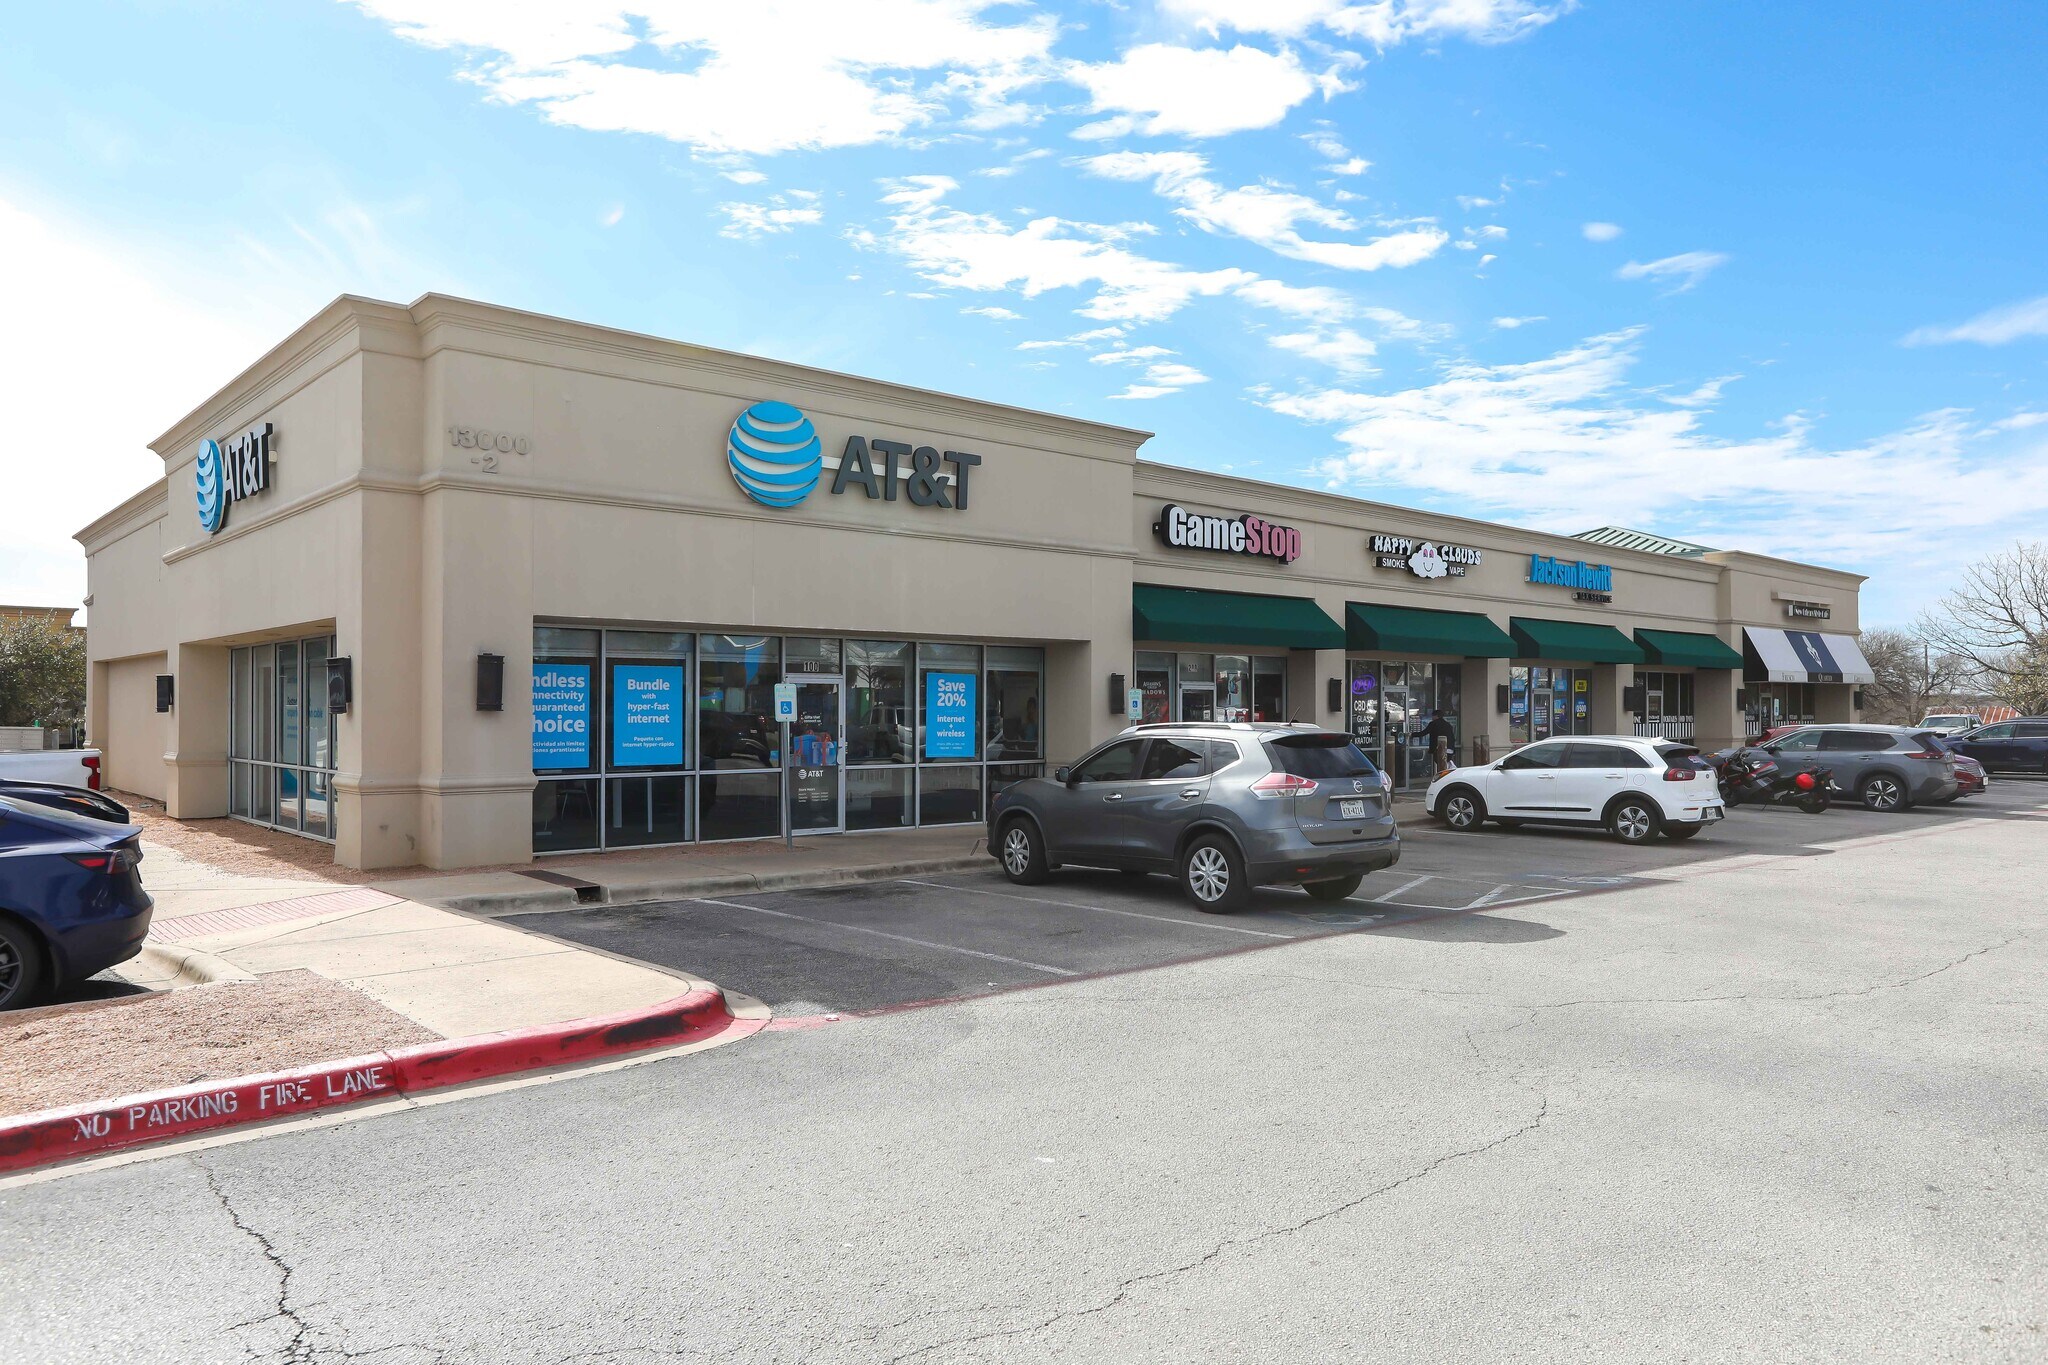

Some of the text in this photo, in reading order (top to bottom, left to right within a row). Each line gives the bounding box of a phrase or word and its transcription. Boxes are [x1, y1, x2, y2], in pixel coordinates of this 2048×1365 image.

[448, 425, 531, 455] 13000
[224, 423, 273, 505] AT&T
[831, 435, 982, 510] AT&T
[1168, 506, 1302, 562] GameStop
[1374, 535, 1482, 566] HAPPY CLOUDS
[1382, 557, 1465, 576] SMOKE VAPE
[1530, 553, 1612, 592] Jackson Hewitt
[804, 661, 819, 672] 100
[532, 672, 585, 688] ndless
[627, 679, 670, 691] Bundle
[937, 679, 966, 692] Save
[1353, 679, 1373, 691] OPEN
[532, 690, 584, 702] nnectivity
[937, 692, 967, 707] 20%
[627, 702, 670, 712] hyper-fast
[1354, 700, 1366, 711] CBD
[532, 715, 586, 733] hoice
[627, 713, 670, 724] internet
[937, 729, 965, 737] wireless
[73, 1066, 387, 1142] NO PARKING FIRE LANE
